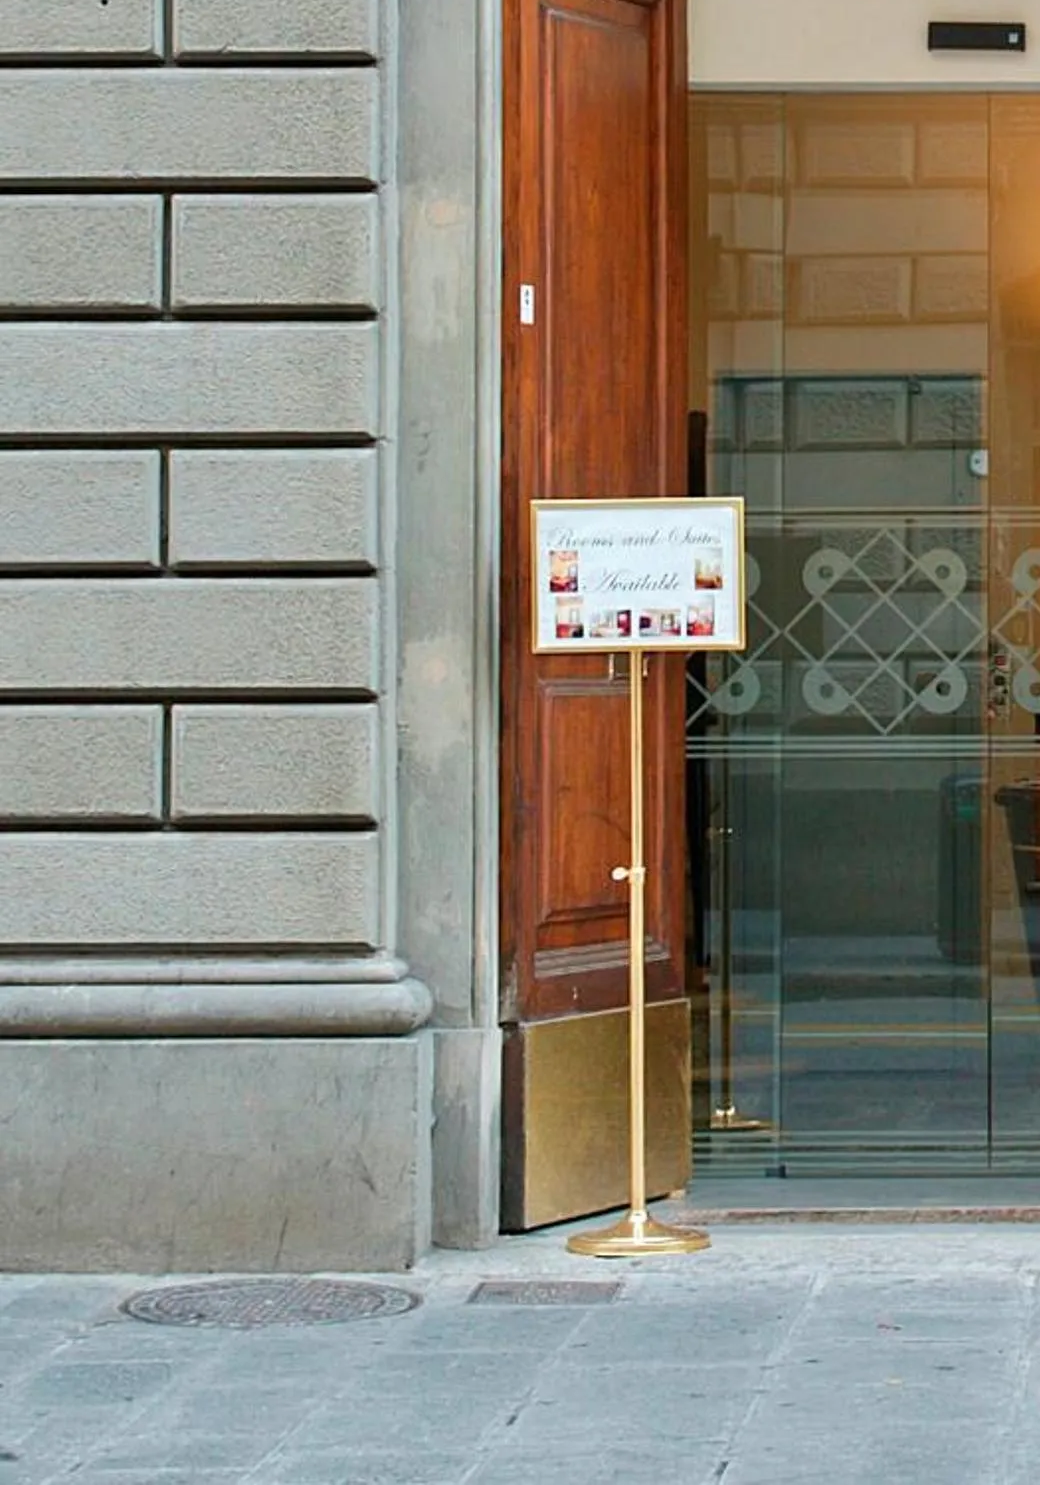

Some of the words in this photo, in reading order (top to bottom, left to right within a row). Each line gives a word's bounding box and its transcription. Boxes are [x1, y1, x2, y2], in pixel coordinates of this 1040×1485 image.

[547, 526, 614, 548] Rooms
[621, 528, 661, 547] and
[583, 568, 681, 594] Available
